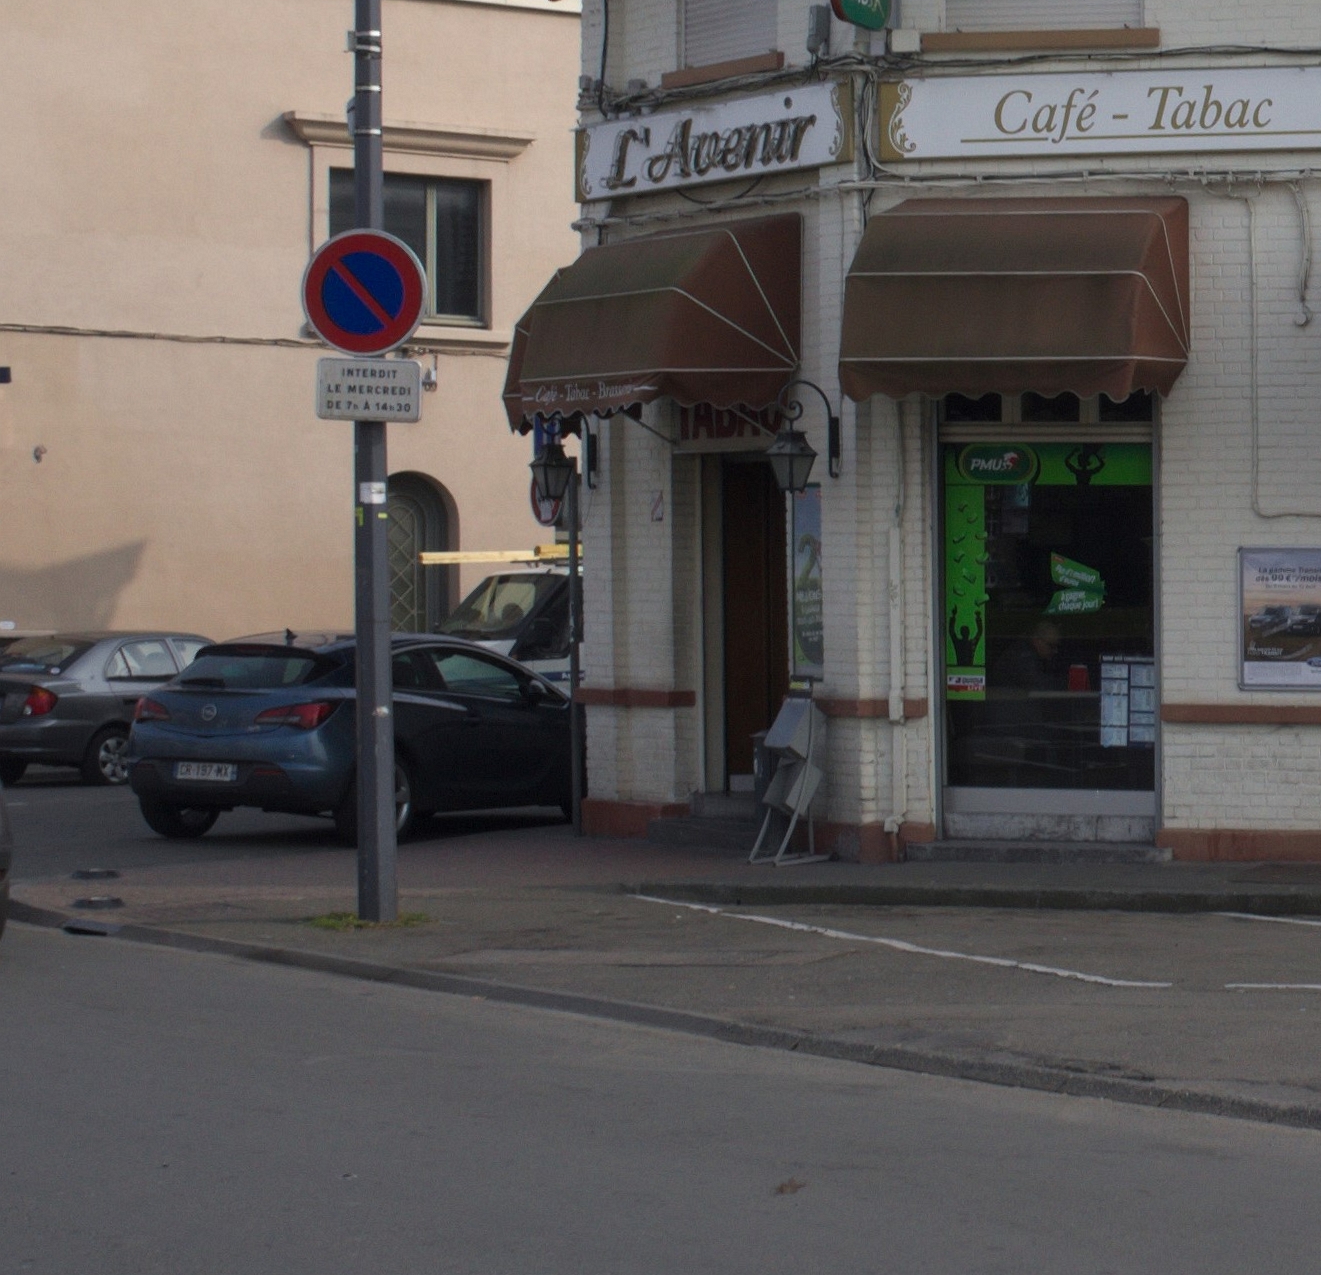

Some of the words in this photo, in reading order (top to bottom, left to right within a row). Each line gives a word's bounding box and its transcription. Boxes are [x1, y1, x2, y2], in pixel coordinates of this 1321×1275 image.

[991, 88, 1098, 146] Café
[1146, 84, 1274, 132] Tabac
[604, 96, 817, 190] L'Avenir
[342, 368, 397, 379] INTERDIT
[327, 384, 341, 393] LE
[347, 385, 411, 396] MERCREDI
[535, 385, 558, 405] Café
[564, 383, 589, 402] Tabac
[327, 400, 342, 410] DE
[347, 402, 358, 410] 7h
[363, 399, 371, 411] À
[375, 403, 411, 413] 14h30
[970, 458, 1003, 471] PMU
